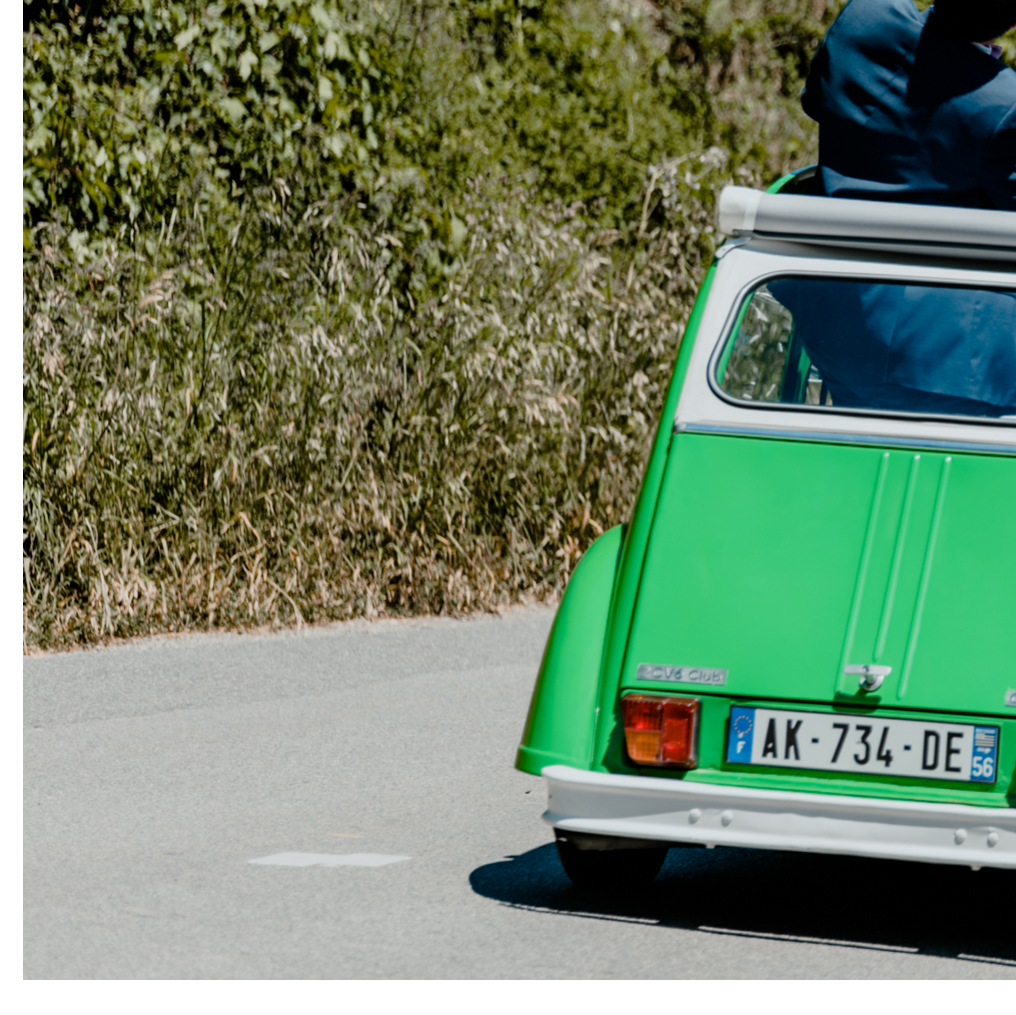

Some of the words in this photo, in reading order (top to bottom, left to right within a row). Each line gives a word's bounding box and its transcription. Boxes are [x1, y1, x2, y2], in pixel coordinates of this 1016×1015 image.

[688, 669, 724, 683] Club
[736, 741, 746, 754] F
[972, 755, 994, 778] 56
